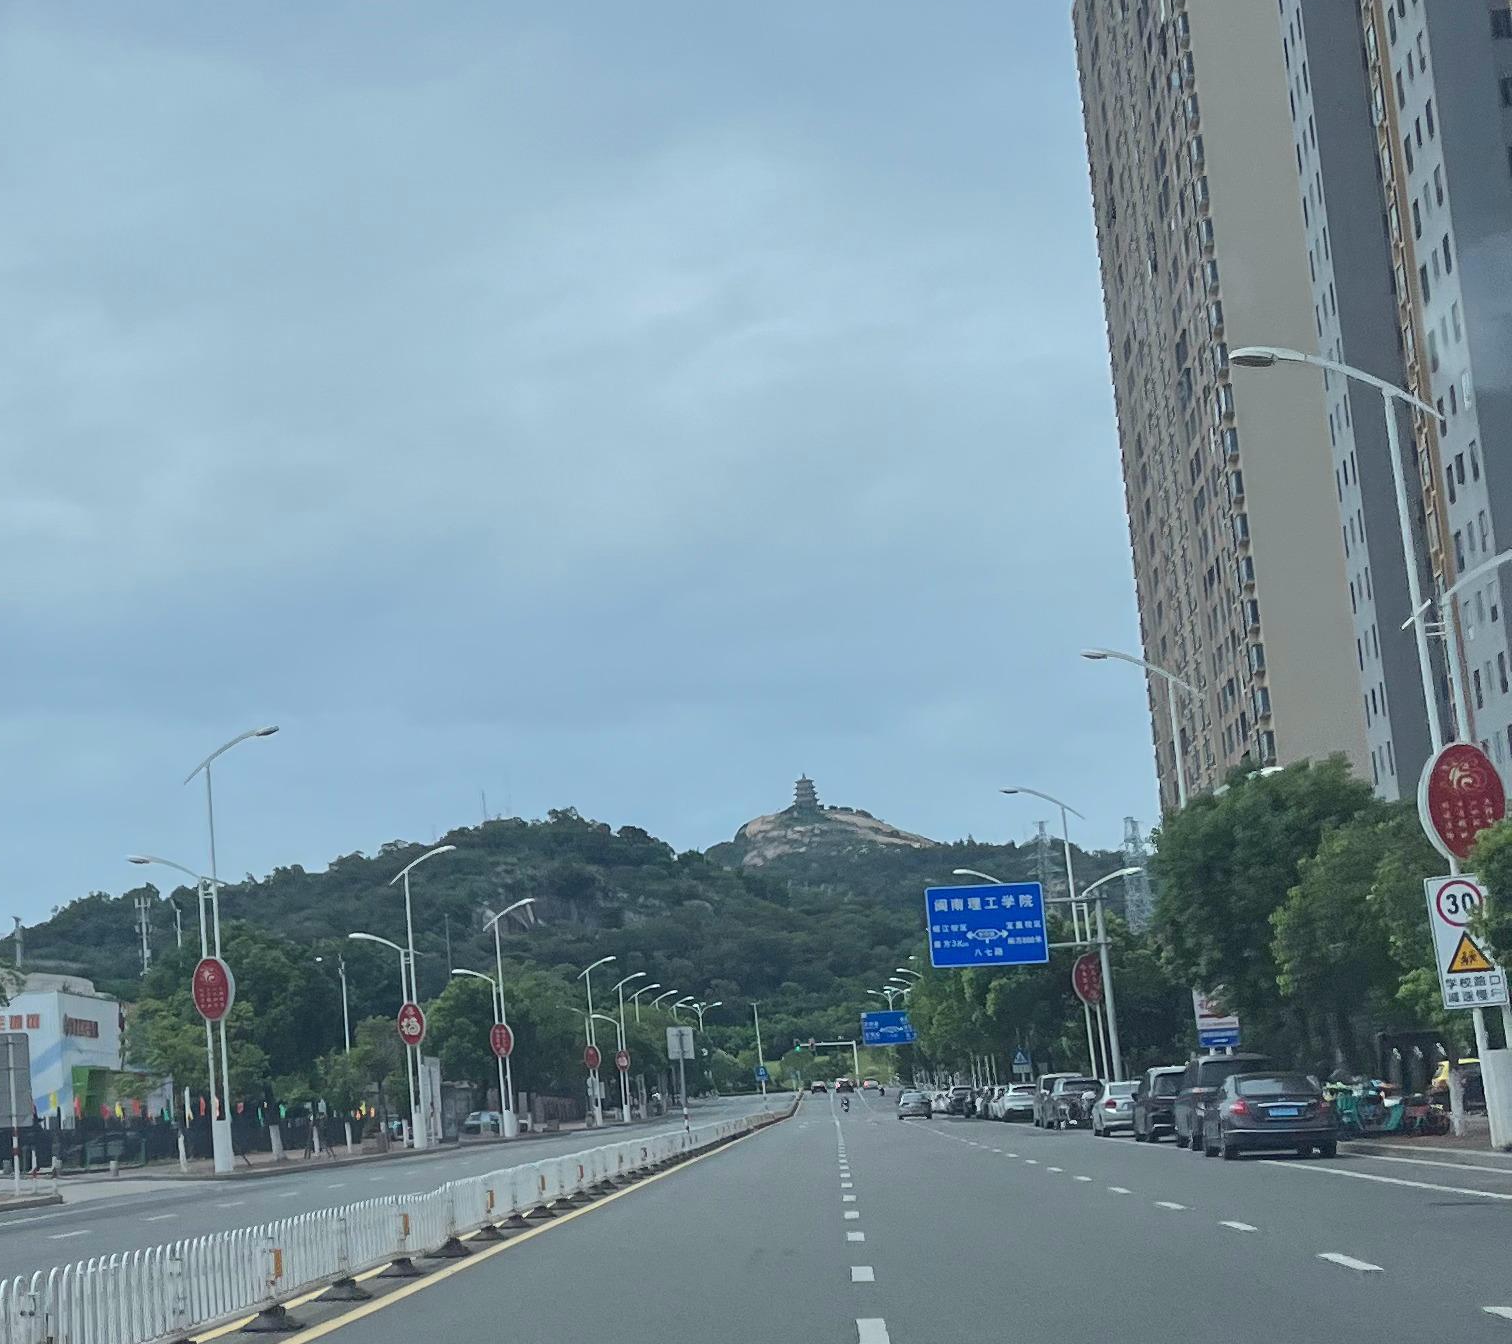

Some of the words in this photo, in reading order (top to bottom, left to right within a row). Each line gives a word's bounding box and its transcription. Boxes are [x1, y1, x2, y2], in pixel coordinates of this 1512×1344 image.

[1446, 892, 1475, 914] 30
[1446, 975, 1500, 989] 学校路口
